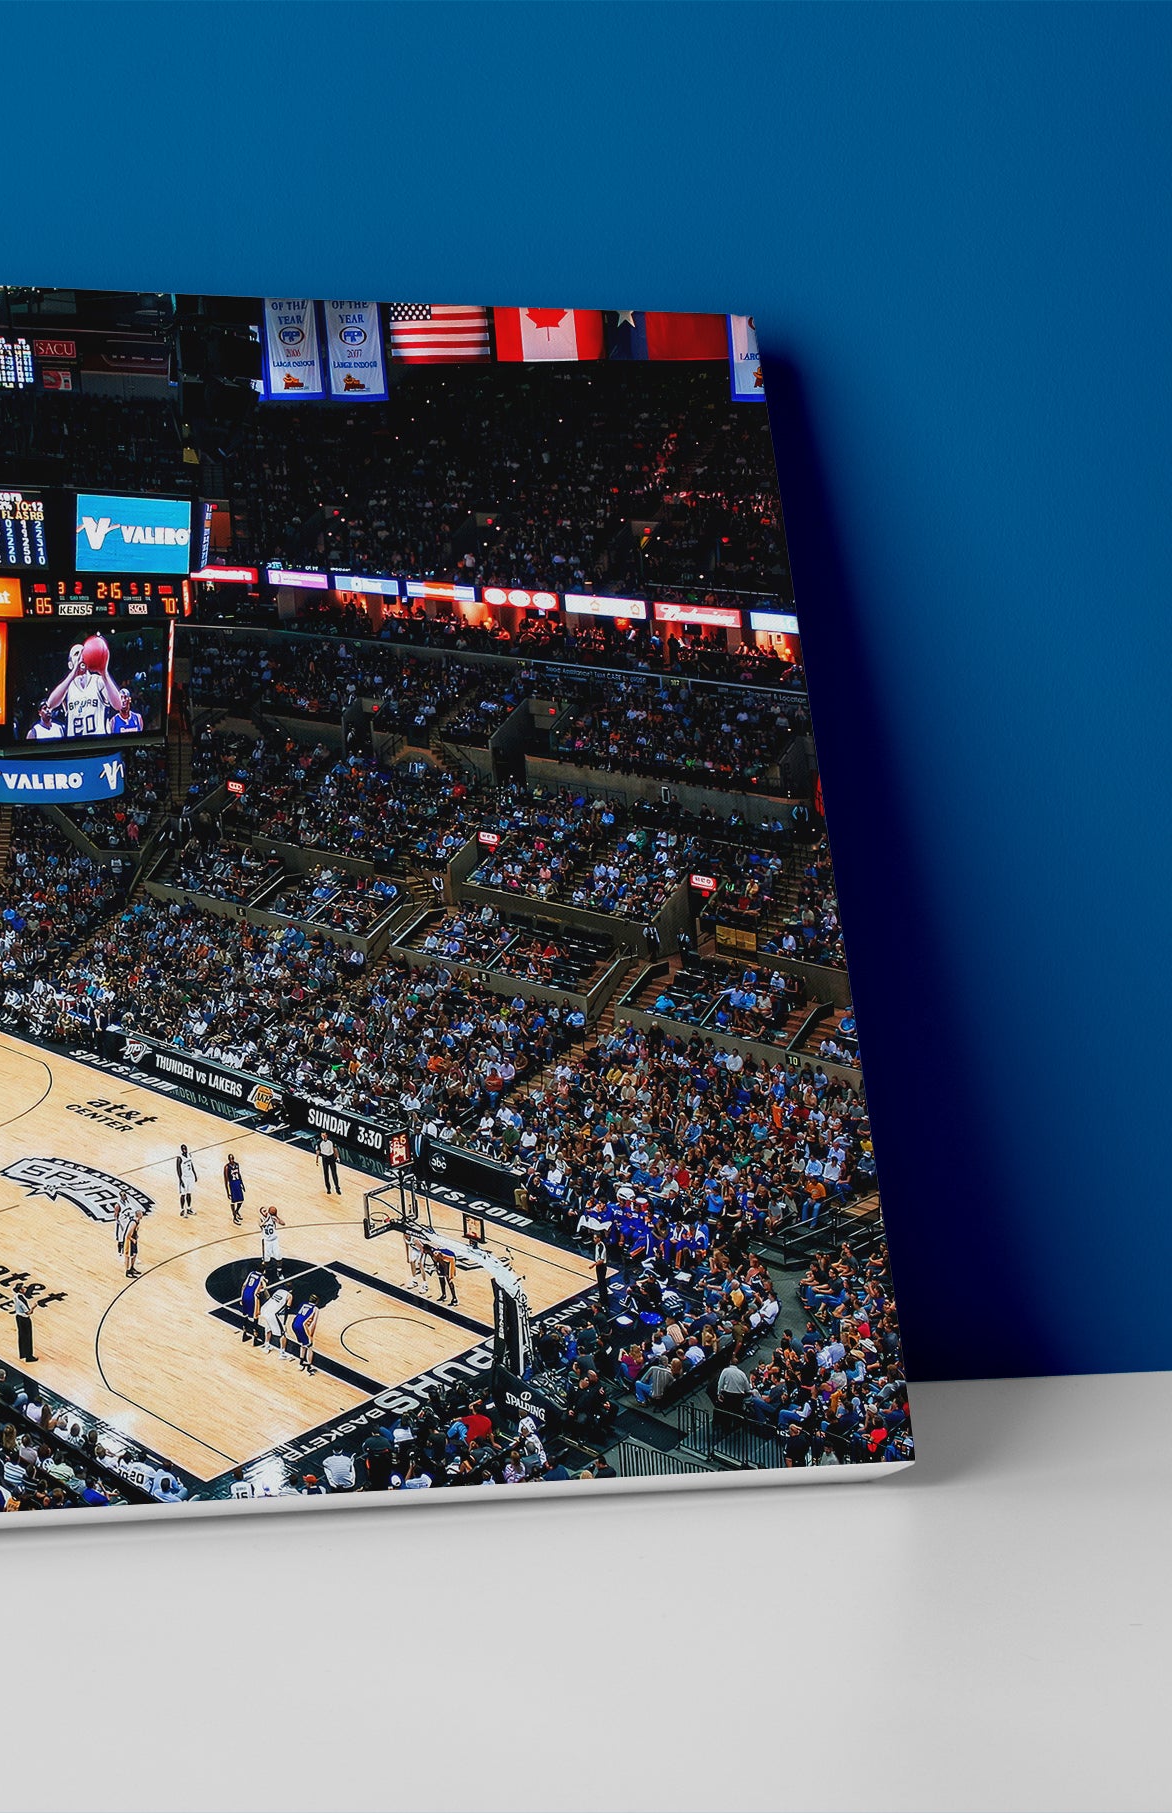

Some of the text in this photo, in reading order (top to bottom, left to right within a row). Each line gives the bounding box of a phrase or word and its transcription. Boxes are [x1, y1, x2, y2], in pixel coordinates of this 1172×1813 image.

[271, 301, 307, 311] OF THE
[332, 300, 368, 310] OF THE
[278, 315, 303, 325] YEAR
[339, 314, 365, 324] YEAR
[2, 511, 14, 519] FL
[16, 511, 29, 519] AS
[5, 519, 11, 527] 0
[35, 521, 42, 529] 2
[6, 529, 13, 537] 2
[36, 530, 42, 538] 2
[120, 525, 190, 546] VALERO
[9, 546, 15, 554] 2
[9, 555, 16, 563] 0
[24, 556, 31, 564] 0
[39, 556, 45, 565] 0
[58, 582, 66, 594] 3
[74, 582, 83, 595] 2
[97, 583, 122, 599] 2:15
[144, 583, 152, 595] 3
[36, 598, 53, 614] 85
[108, 602, 116, 615] 3
[162, 598, 177, 614] 70
[3, 773, 83, 790] VALERO
[788, 1056, 798, 1066] 10
[155, 1054, 194, 1080] THUNDER
[208, 1074, 243, 1098] LAKERS
[65, 1104, 134, 1133] CENTER
[308, 1108, 383, 1149] SUNDAY 3:30
[505, 1391, 547, 1421] SPALDING
[129, 1471, 145, 1484] 20
